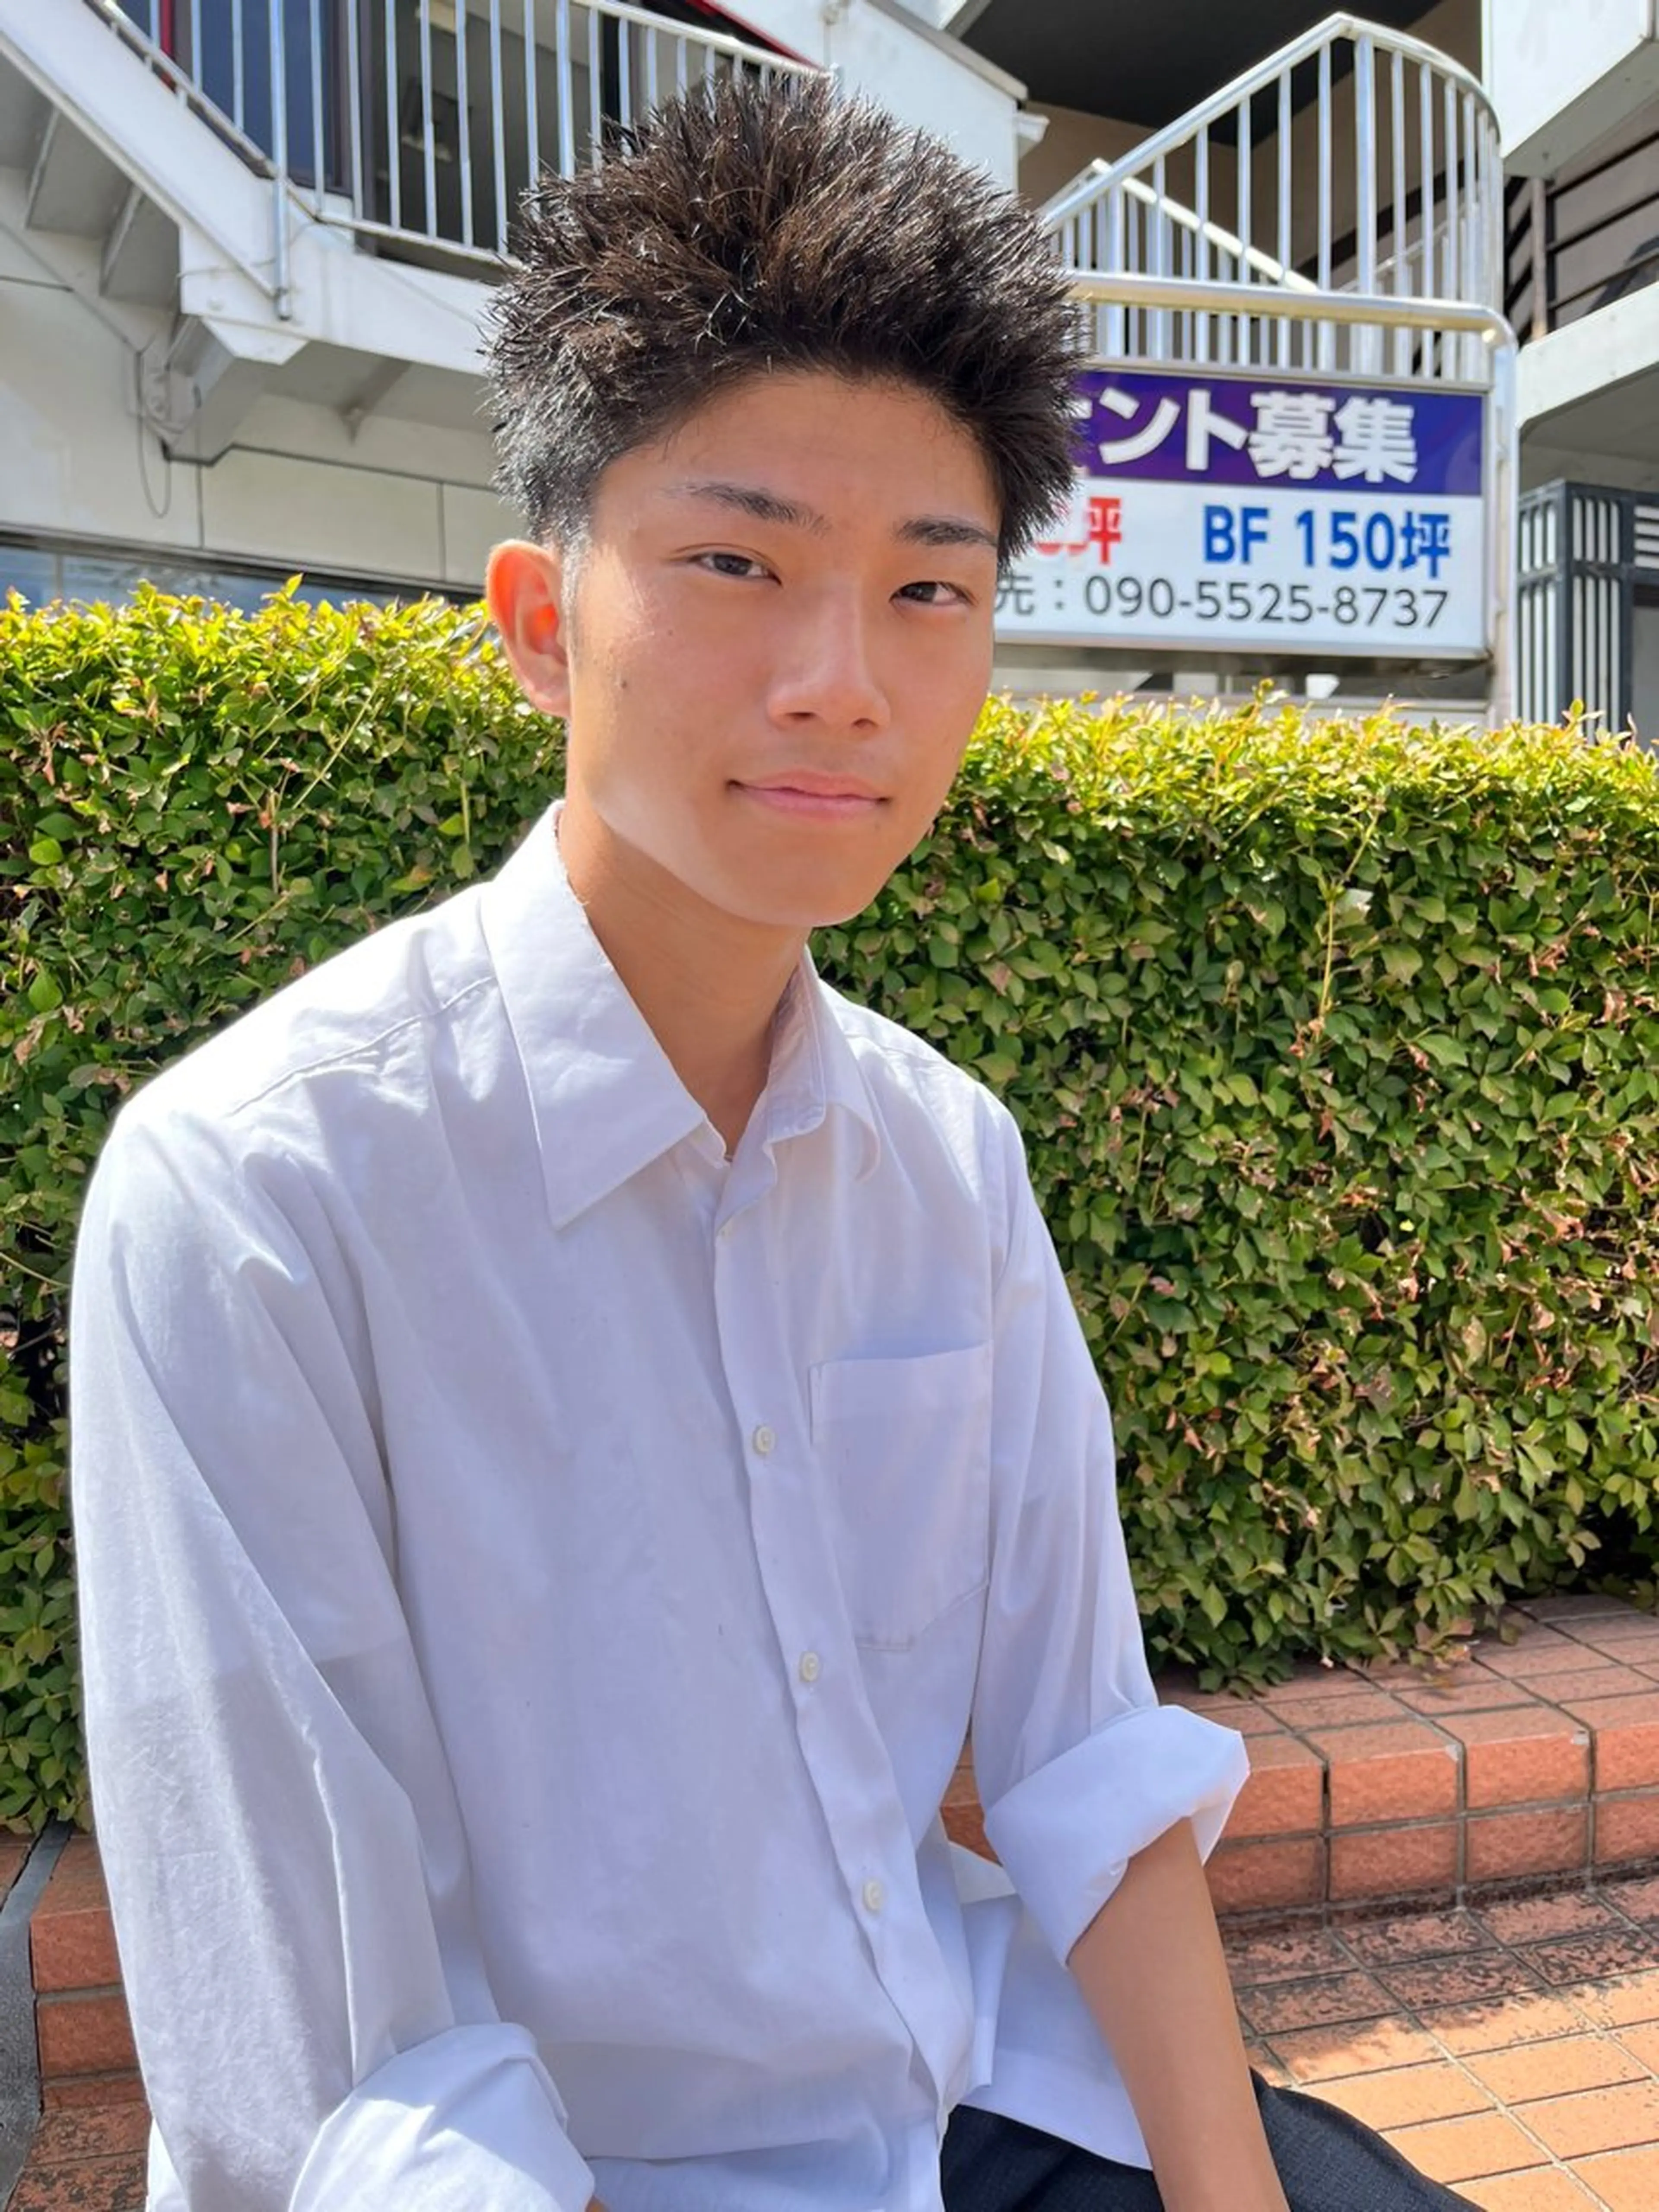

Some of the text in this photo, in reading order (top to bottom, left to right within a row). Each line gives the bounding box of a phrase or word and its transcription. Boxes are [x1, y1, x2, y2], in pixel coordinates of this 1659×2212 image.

[1061, 387, 1417, 483] ント募集
[1204, 506, 1268, 563] BF
[1296, 510, 1449, 578] 150坪
